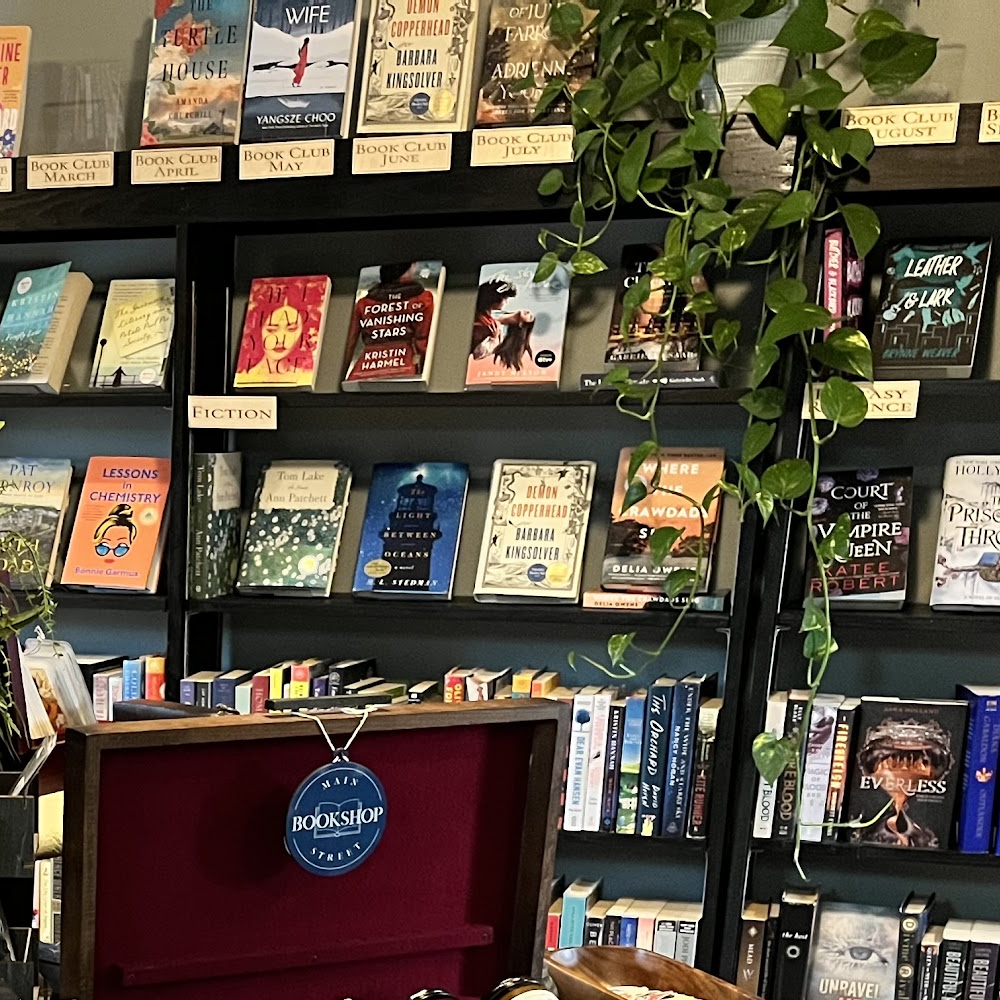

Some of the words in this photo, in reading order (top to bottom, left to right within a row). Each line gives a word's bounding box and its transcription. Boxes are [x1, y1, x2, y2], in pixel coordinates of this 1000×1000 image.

[286, 5, 330, 24] WIFE
[391, 19, 450, 38] COPPERHEAD
[161, 25, 236, 48] TURTLE
[396, 48, 438, 66] BARBARA
[162, 60, 228, 82] HOUSE
[386, 72, 443, 88] KINGSOLVER
[256, 114, 302, 125] YANGSZE
[304, 112, 336, 124] CHOO
[846, 114, 896, 126] BOOK
[903, 112, 954, 124] CLUB
[476, 135, 521, 146] BOOK
[527, 132, 572, 144] CLUB
[876, 126, 937, 138] UGUST
[244, 150, 284, 162] BOOK
[290, 146, 330, 158] CLUB
[356, 144, 399, 155] BOOK
[404, 142, 446, 152] CLUB
[502, 146, 542, 158] JULY
[30, 161, 68, 172] BOOK
[72, 158, 110, 170] CLUB
[136, 155, 175, 166] BOOK
[179, 154, 218, 165] CLUB
[270, 160, 303, 172] MAY
[380, 154, 420, 168] JUNE
[44, 172, 96, 182] MARCH
[154, 166, 198, 178] APRIL
[904, 254, 963, 278] LEATHER
[904, 292, 919, 310] &
[918, 288, 954, 308] LARK
[364, 301, 409, 315] FOREST
[359, 312, 424, 328] VANISHING
[371, 327, 407, 339] STARS
[364, 348, 407, 360] KRISTIN
[362, 358, 406, 370] HARMEL
[192, 406, 272, 420] FICTION
[9, 464, 38, 477] PAT
[102, 468, 159, 479] LESSONS
[277, 470, 298, 481] Tom
[301, 470, 325, 482] Lake
[122, 482, 132, 490] in
[526, 485, 558, 499] DEMON
[830, 482, 894, 500] COURT
[90, 492, 162, 504] CHEMISTRY
[266, 492, 286, 502] Ann
[288, 493, 328, 503] Patchett
[510, 504, 568, 519] COPPERHEAD
[854, 502, 868, 510] OF
[396, 512, 432, 520] LIGHT
[515, 527, 555, 542] BARBARA
[505, 546, 560, 561] KINGSOLVER
[74, 566, 104, 576] Bonnie
[612, 564, 648, 574] DELIA
[650, 694, 667, 716] THE
[684, 687, 694, 715] UNDER
[612, 709, 620, 740] KRISTIN
[684, 717, 692, 732] THE
[576, 736, 586, 755] DEAR
[672, 725, 681, 754] NANCY
[681, 734, 690, 756] WIDE
[648, 720, 665, 776] ORCHARD
[608, 742, 618, 771] HANNAH
[574, 755, 584, 779] EVAN
[670, 756, 678, 786] HORAN
[678, 758, 687, 776] AND
[322, 776, 358, 790] MAIN
[860, 776, 947, 796] EVERLESS
[570, 778, 582, 806] HANSEN
[652, 784, 661, 809] DAVID
[692, 792, 706, 826] RUNNER
[292, 806, 384, 832] BOOKSHOP
[310, 842, 361, 862] STREET
[746, 944, 754, 964] MEAD
[941, 951, 962, 995] BEAUTIFUL
[819, 978, 880, 999] UNRAVEL
